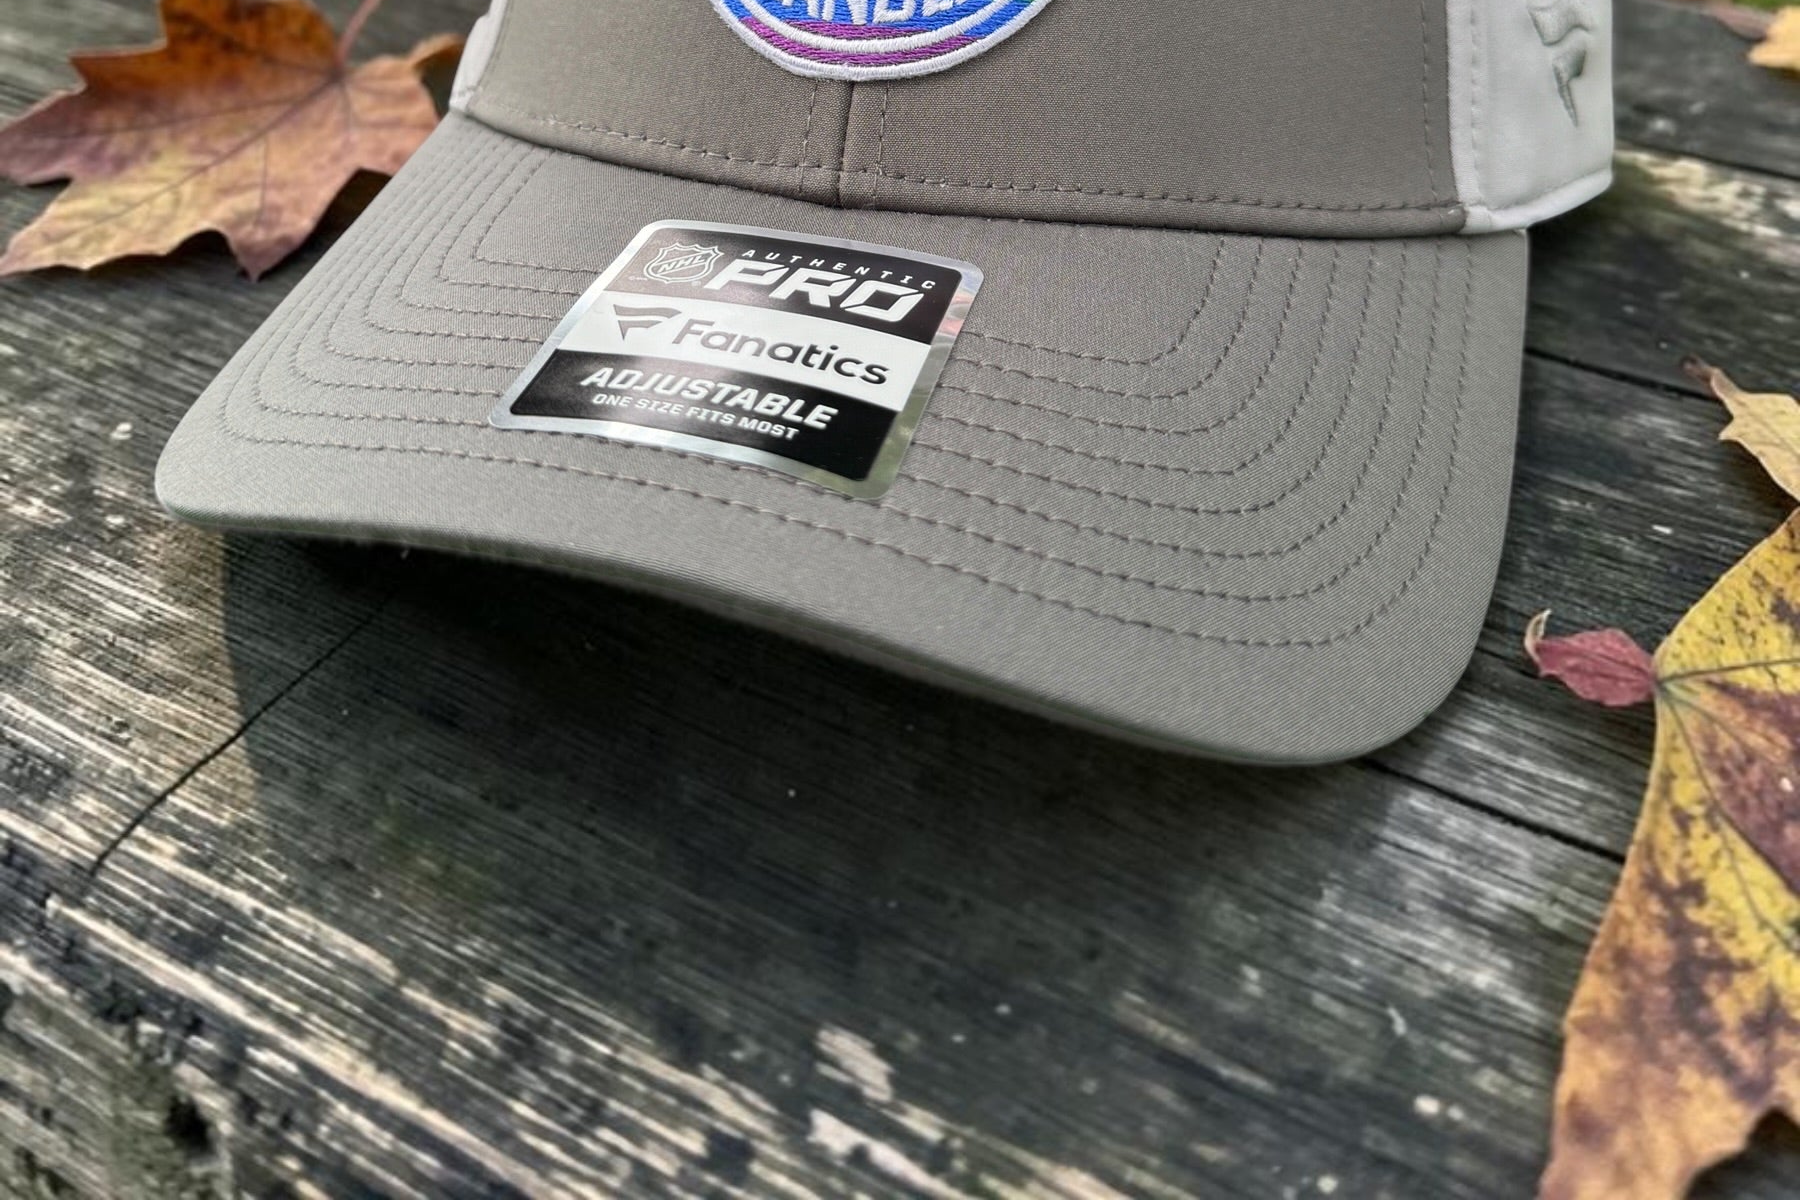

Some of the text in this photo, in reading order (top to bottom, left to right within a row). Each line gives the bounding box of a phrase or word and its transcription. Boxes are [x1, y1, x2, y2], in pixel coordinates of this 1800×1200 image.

[657, 254, 706, 274] NHL
[703, 258, 925, 323] PRO
[741, 248, 938, 290] AUTHENTIC
[672, 316, 891, 386] Fanatics
[580, 366, 839, 431] ADJUSTABLE
[592, 393, 799, 441] ONE SIZE FITS MOST
